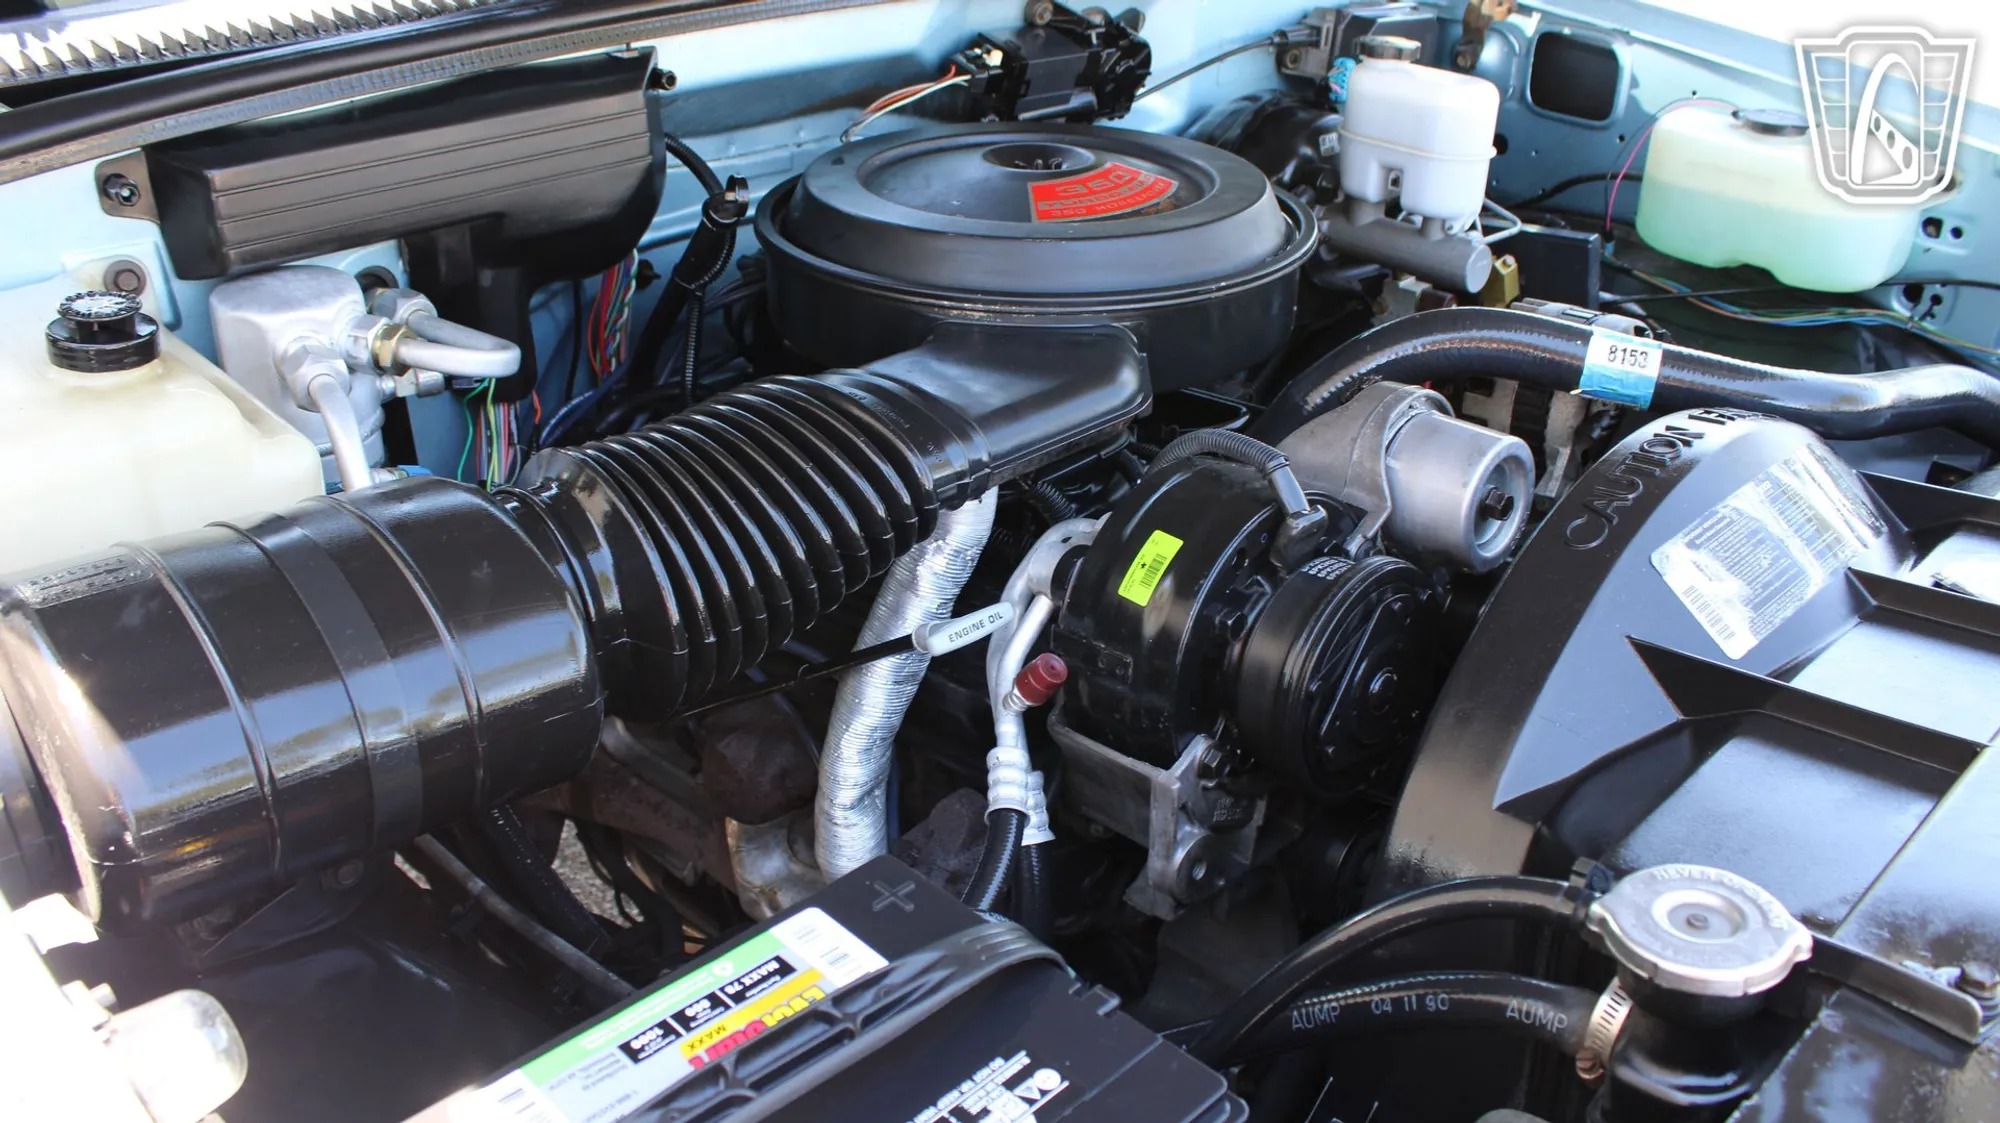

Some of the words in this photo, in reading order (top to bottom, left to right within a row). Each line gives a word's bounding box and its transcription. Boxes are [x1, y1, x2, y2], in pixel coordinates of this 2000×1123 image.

[1055, 171, 1133, 196] 350
[1608, 344, 1648, 369] 8153
[1564, 424, 1706, 550] CAUTION
[948, 619, 986, 643] ENGINE
[988, 612, 1004, 624] OIL
[740, 960, 780, 986] MAXX
[1291, 1003, 1340, 1031] AUMP
[1371, 998, 1392, 1014] 04
[1505, 998, 1568, 1033] AUMP
[688, 1024, 728, 1051] MAXX
